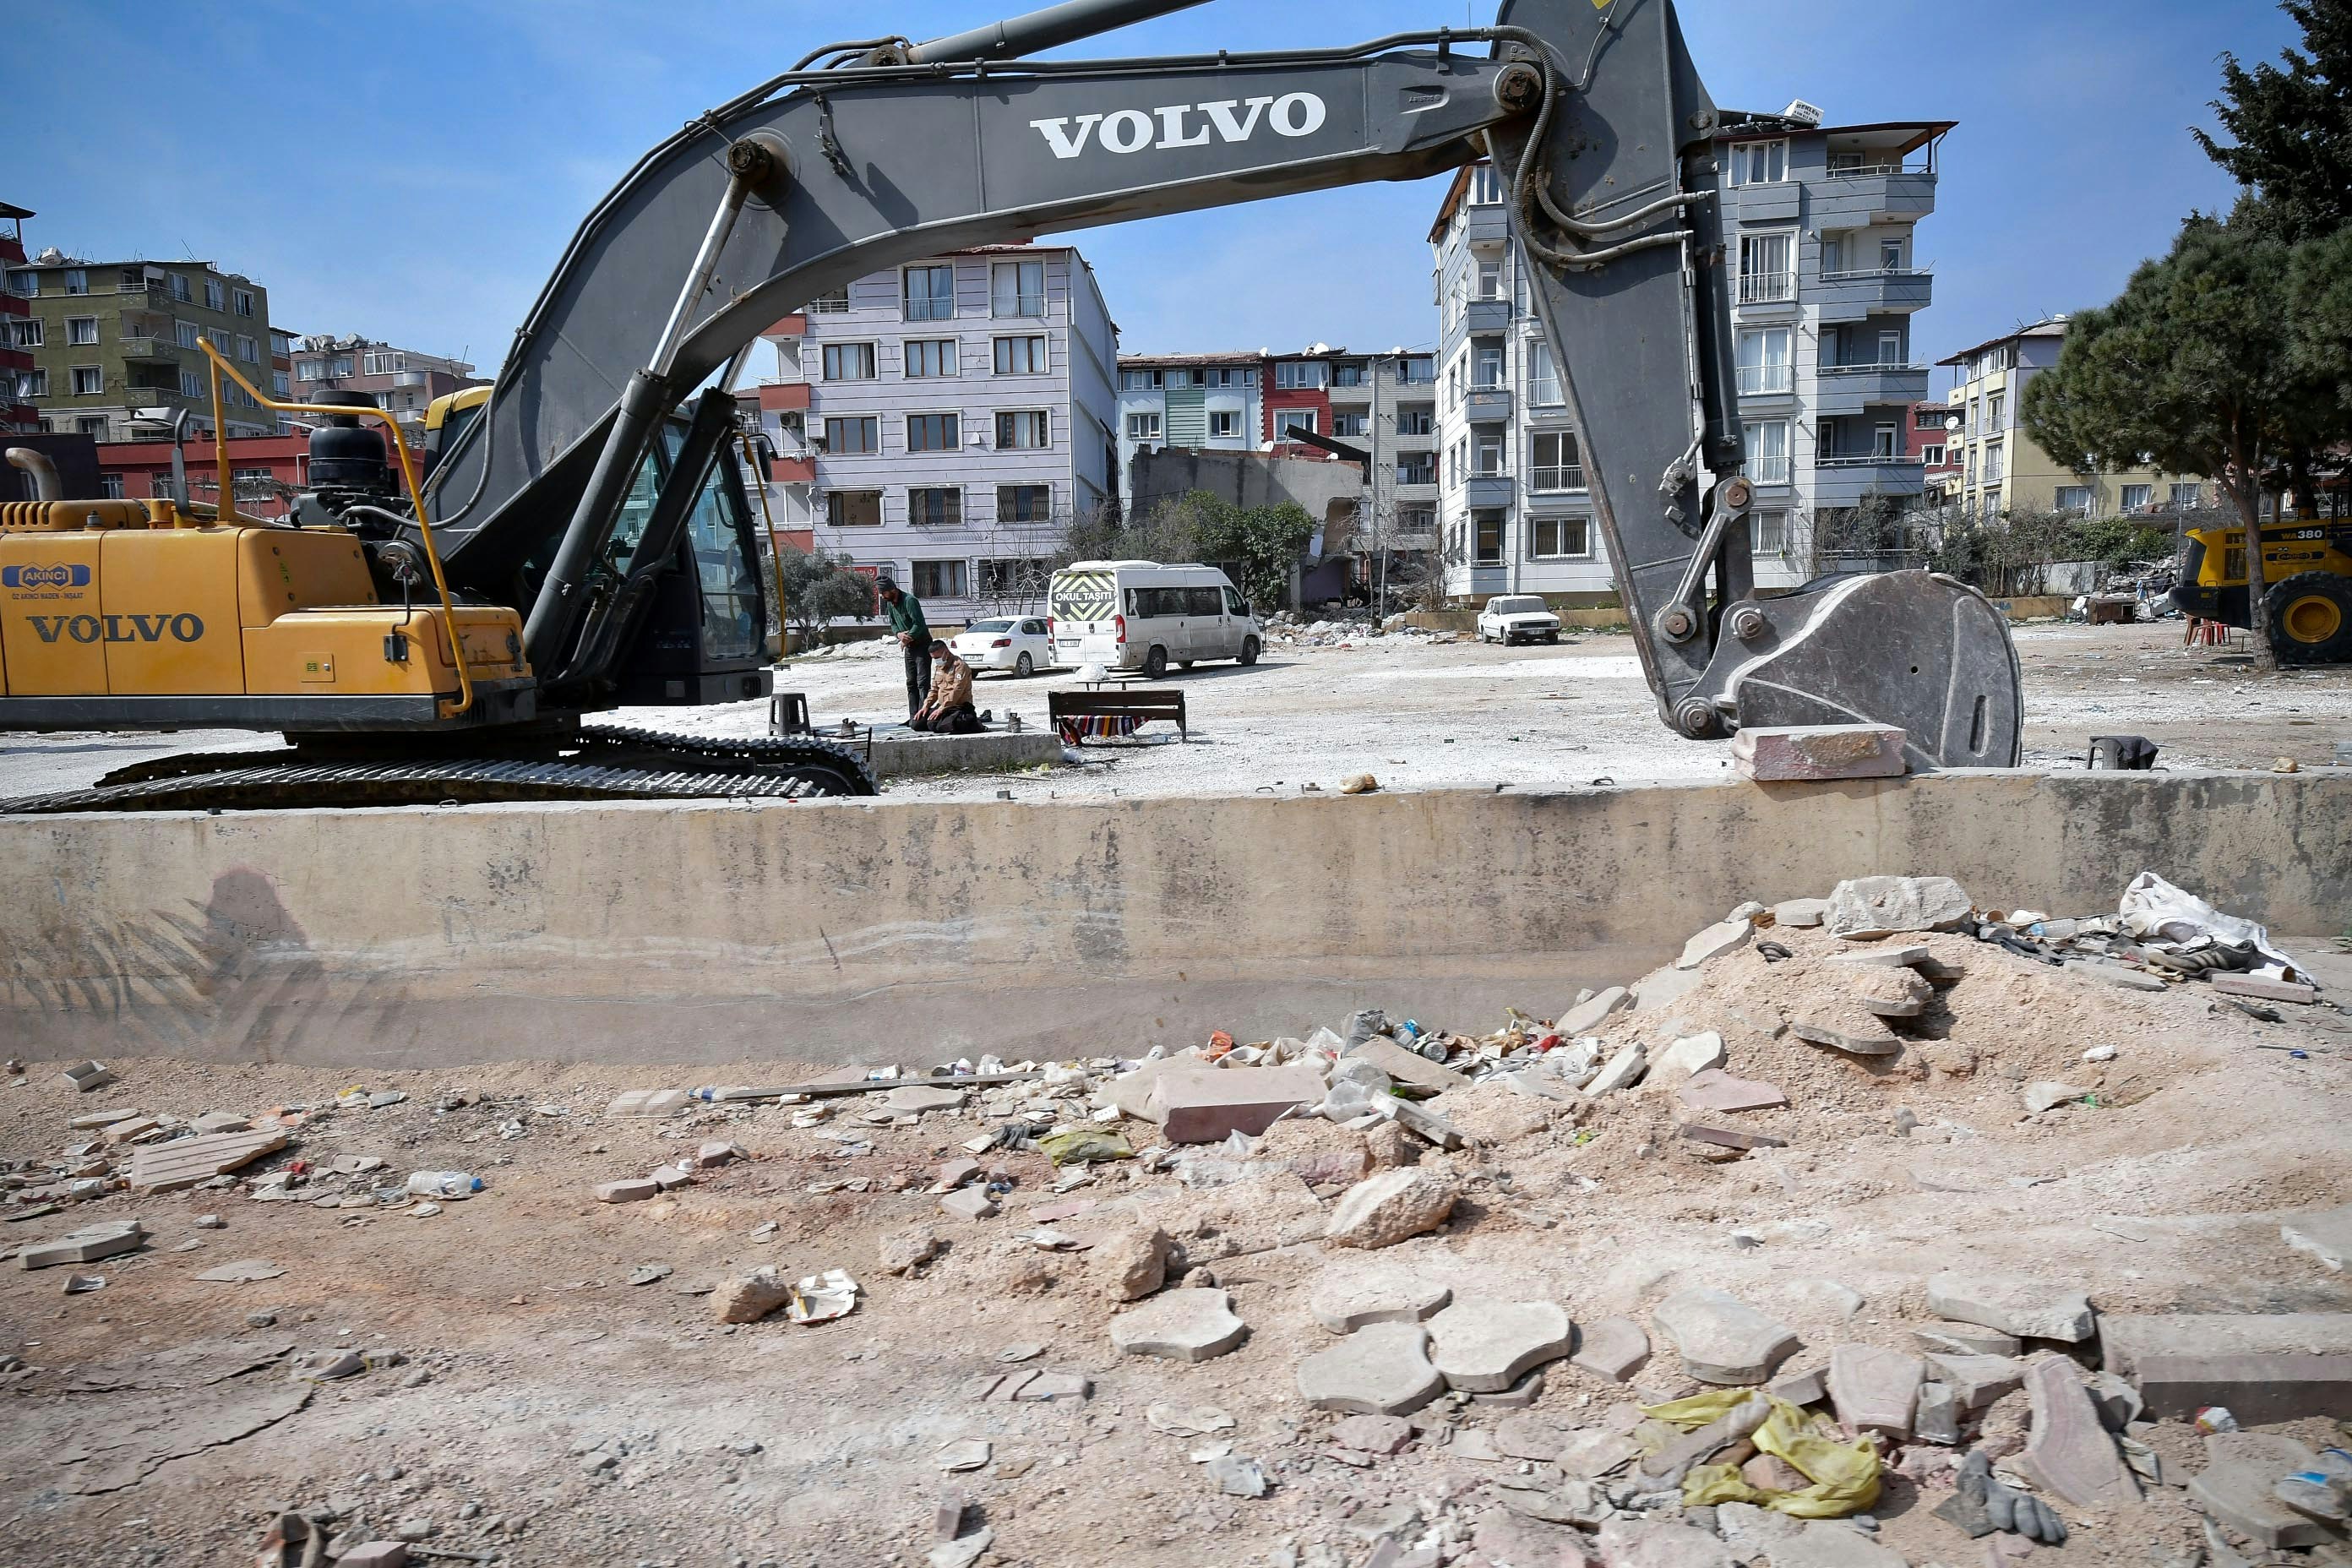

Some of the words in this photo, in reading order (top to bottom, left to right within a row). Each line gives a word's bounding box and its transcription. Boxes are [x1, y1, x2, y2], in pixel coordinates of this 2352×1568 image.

[1030, 92, 1326, 159] VOLVO
[25, 571, 66, 580] AKINCI
[1055, 592, 1082, 602] OKUL
[1083, 591, 1112, 602] TAŞITI
[25, 612, 204, 644] VOLVO
